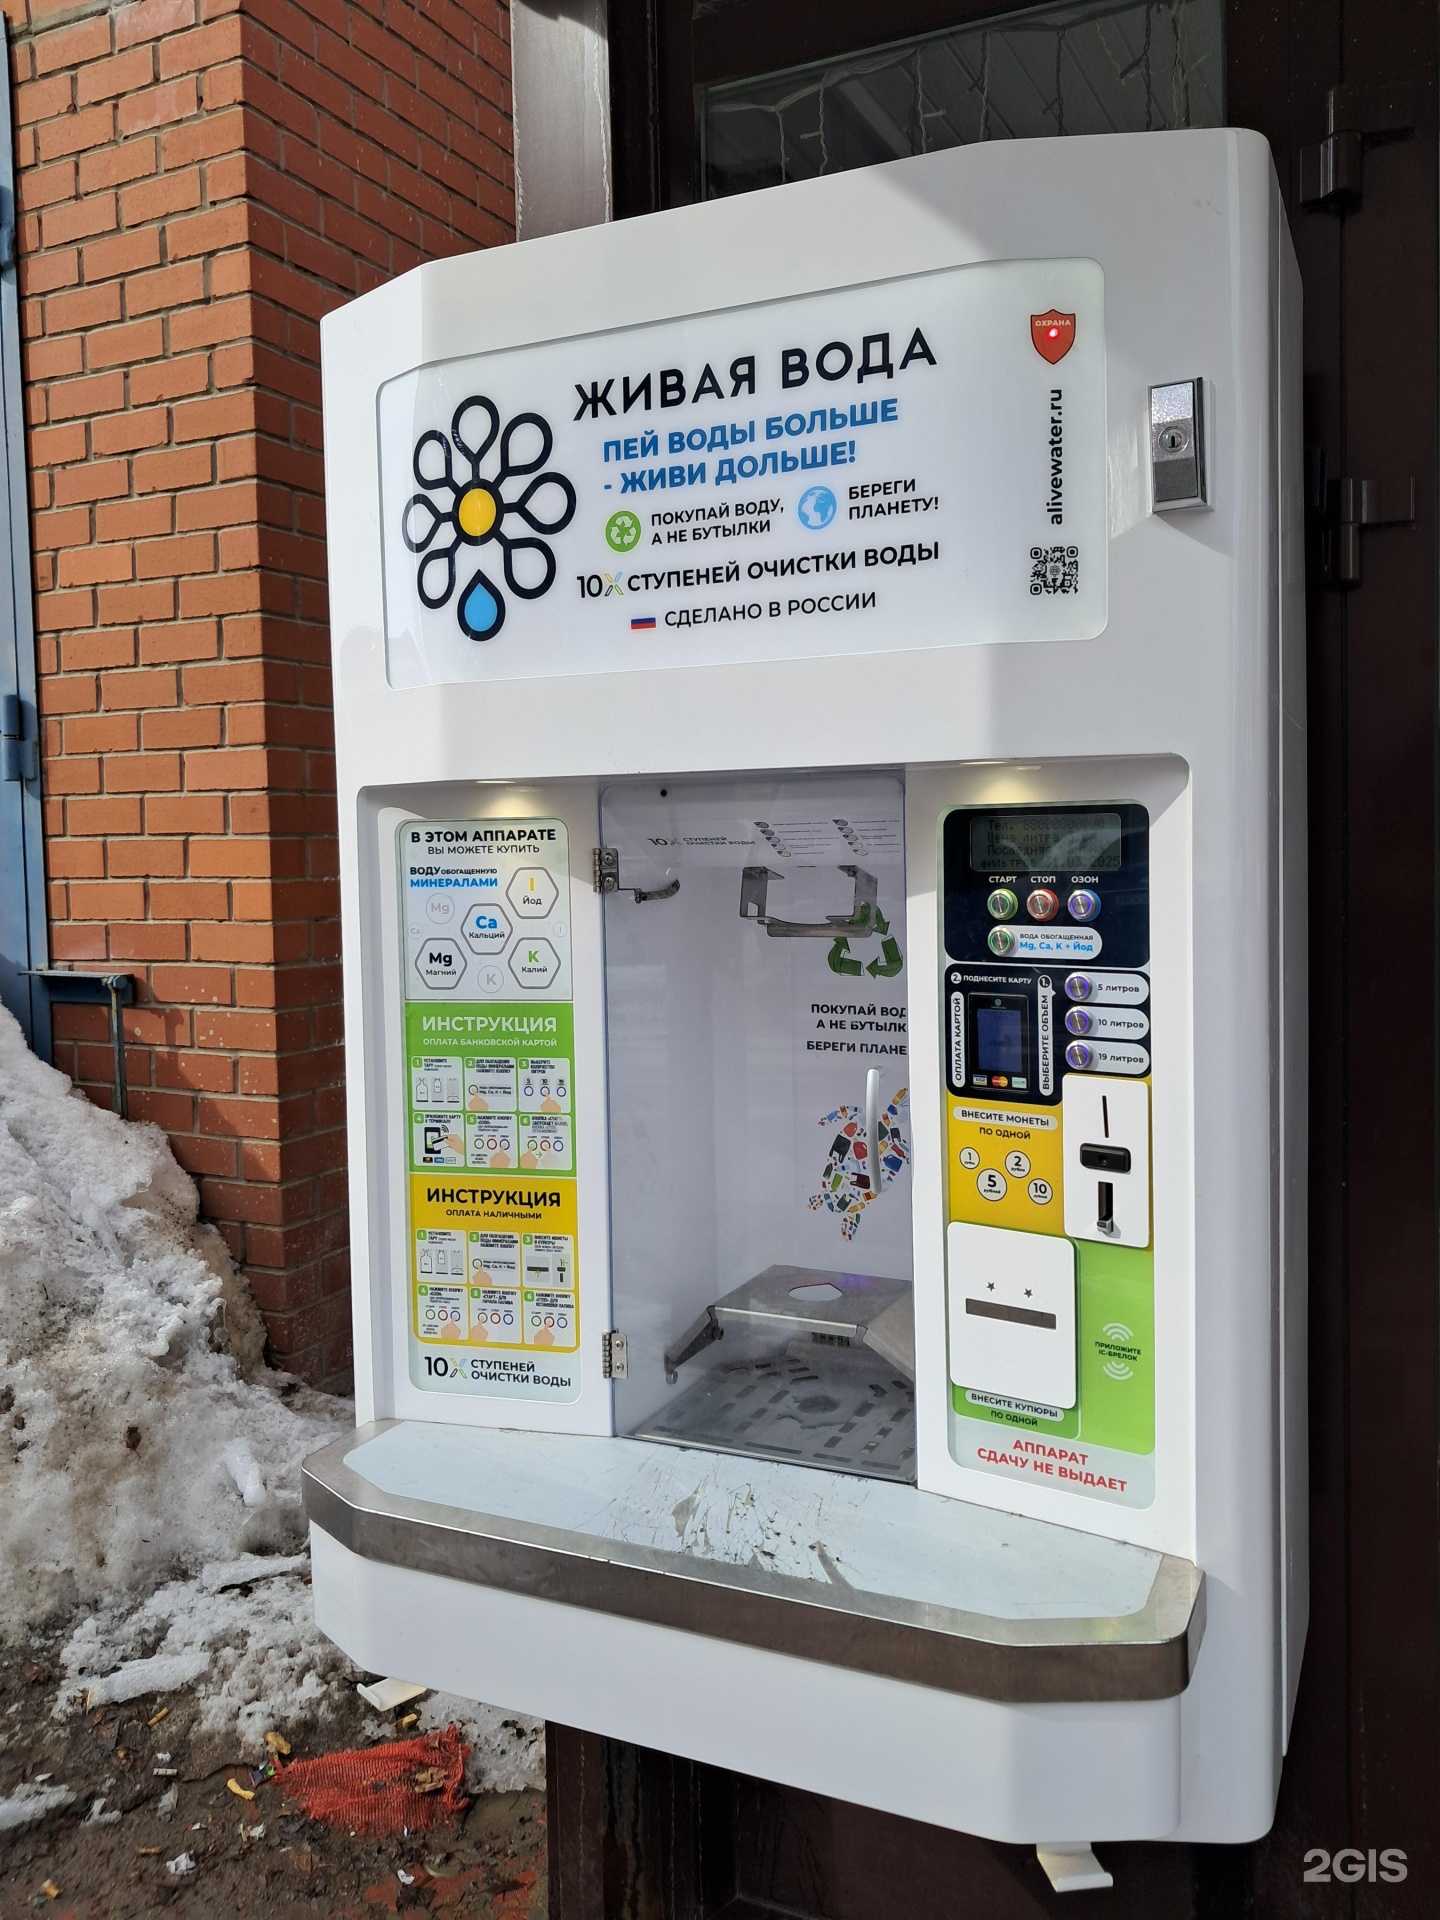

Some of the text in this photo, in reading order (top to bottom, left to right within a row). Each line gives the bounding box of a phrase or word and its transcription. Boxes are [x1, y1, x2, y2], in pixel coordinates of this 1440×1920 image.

[1035, 319, 1072, 328] ОХРАНА
[573, 327, 937, 421] ЖИВАЯ ВОДА
[603, 398, 899, 463] ПЕЙ ВОДЫ БОЛЬШЕ
[1047, 389, 1063, 525] alivewater.ru
[620, 462, 706, 494] ЖИВИ
[715, 440, 856, 486] ДОЛЬШЕ!
[848, 478, 917, 500] БЕРЕГИ
[651, 498, 785, 527] ПОКУПАЙ ВОДУ,
[848, 496, 939, 521] ПЛАНЕТУ!
[651, 519, 771, 545] А НЕ БУТЫЛКИ
[627, 560, 740, 592] СТУПЕНЕЙ
[747, 550, 856, 580] ОЧИСТКИ
[864, 541, 940, 567] ВОДЫ
[665, 591, 877, 628] СДЕЛАНО В РОССИИ
[411, 829, 556, 843] В ЭТОМ АППАРАТЕ
[428, 844, 540, 854] ВЫ МОЖЕТЕ КУПИТЬ
[410, 867, 440, 876] ВОДУ
[410, 878, 498, 888] МИНЕРАЛАМИ
[1071, 875, 1099, 883] ОЗОН
[523, 896, 542, 905] Йод
[431, 903, 449, 914] Mg
[469, 931, 505, 940] Кальций
[1073, 941, 1093, 952] Йод
[429, 952, 453, 967] Mg
[426, 968, 457, 977] Магний
[521, 965, 548, 974] Калий
[963, 975, 1007, 984] ПОДНЕСИТЕ
[1008, 977, 1032, 985] КАРТУ
[1105, 984, 1140, 994] литров
[811, 1003, 876, 1015] ПОКУПАЙ
[953, 997, 961, 1037] КАРТОЙ
[422, 1015, 557, 1034] ИНСТРУКЦИЯ
[816, 1019, 825, 1029] А
[829, 1020, 847, 1029] НЕ
[1110, 1019, 1144, 1029] литров
[423, 1037, 557, 1047] ОПЛАТА БАНКОВСКОЙ КАРТОЙ
[807, 1041, 856, 1052] БЕРЕГИ
[1110, 1054, 1144, 1064] литров
[961, 1109, 1049, 1127] ВНЕСИТЕ МОНЕТЫ
[979, 1127, 1031, 1140] ПО ОДНОЙ
[967, 1152, 972, 1161] 1
[1013, 1156, 1022, 1167] 2
[987, 1175, 997, 1188] 5
[1033, 1183, 1047, 1194] 10
[427, 1188, 560, 1208] ИНСТРУКЦИЯ
[446, 1208, 542, 1220] ОПЛАТА НАЛИЧНЫМИ
[1095, 1341, 1141, 1355] ПРИЛОЖИТЕ
[471, 1359, 535, 1372] СТУПЕНЕЙ
[471, 1370, 571, 1388] ОЧИСТКИ ВОДЫ
[971, 1393, 1058, 1417] ВНЕСИТЕ КУПЮРЫ
[991, 1410, 1038, 1426] ПО ОДНОЙ
[1012, 1439, 1089, 1466] АППАРАТ
[976, 1447, 1128, 1492] СДАЧУ НЕ ВЫДАЕТ
